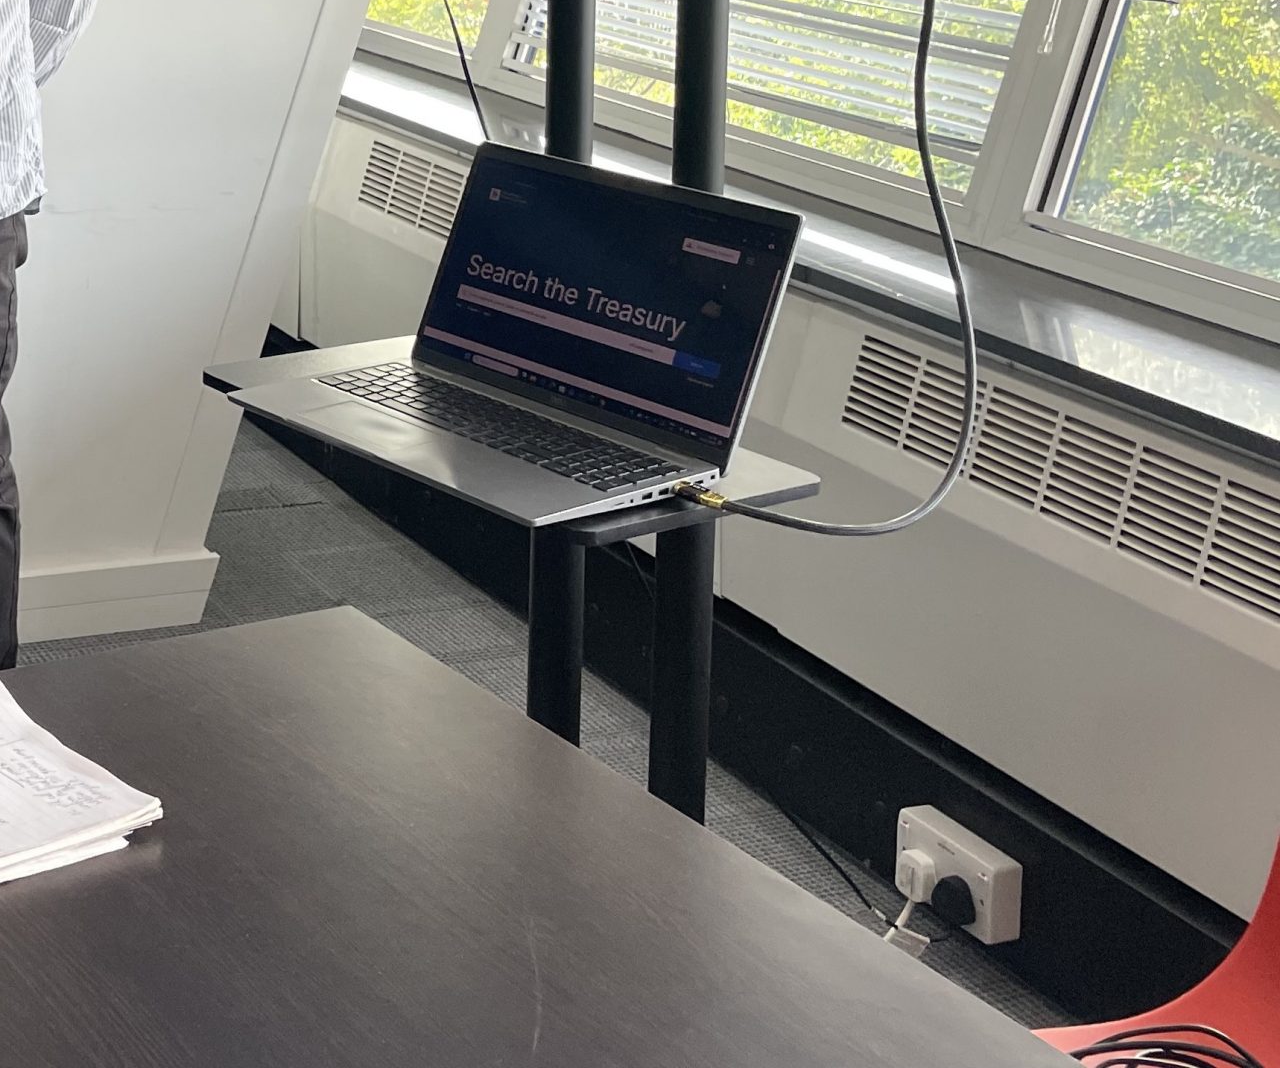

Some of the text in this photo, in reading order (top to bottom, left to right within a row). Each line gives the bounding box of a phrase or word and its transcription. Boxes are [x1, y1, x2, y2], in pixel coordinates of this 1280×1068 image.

[467, 254, 539, 294] Search
[544, 277, 579, 305] the
[586, 287, 687, 342] Treasury
